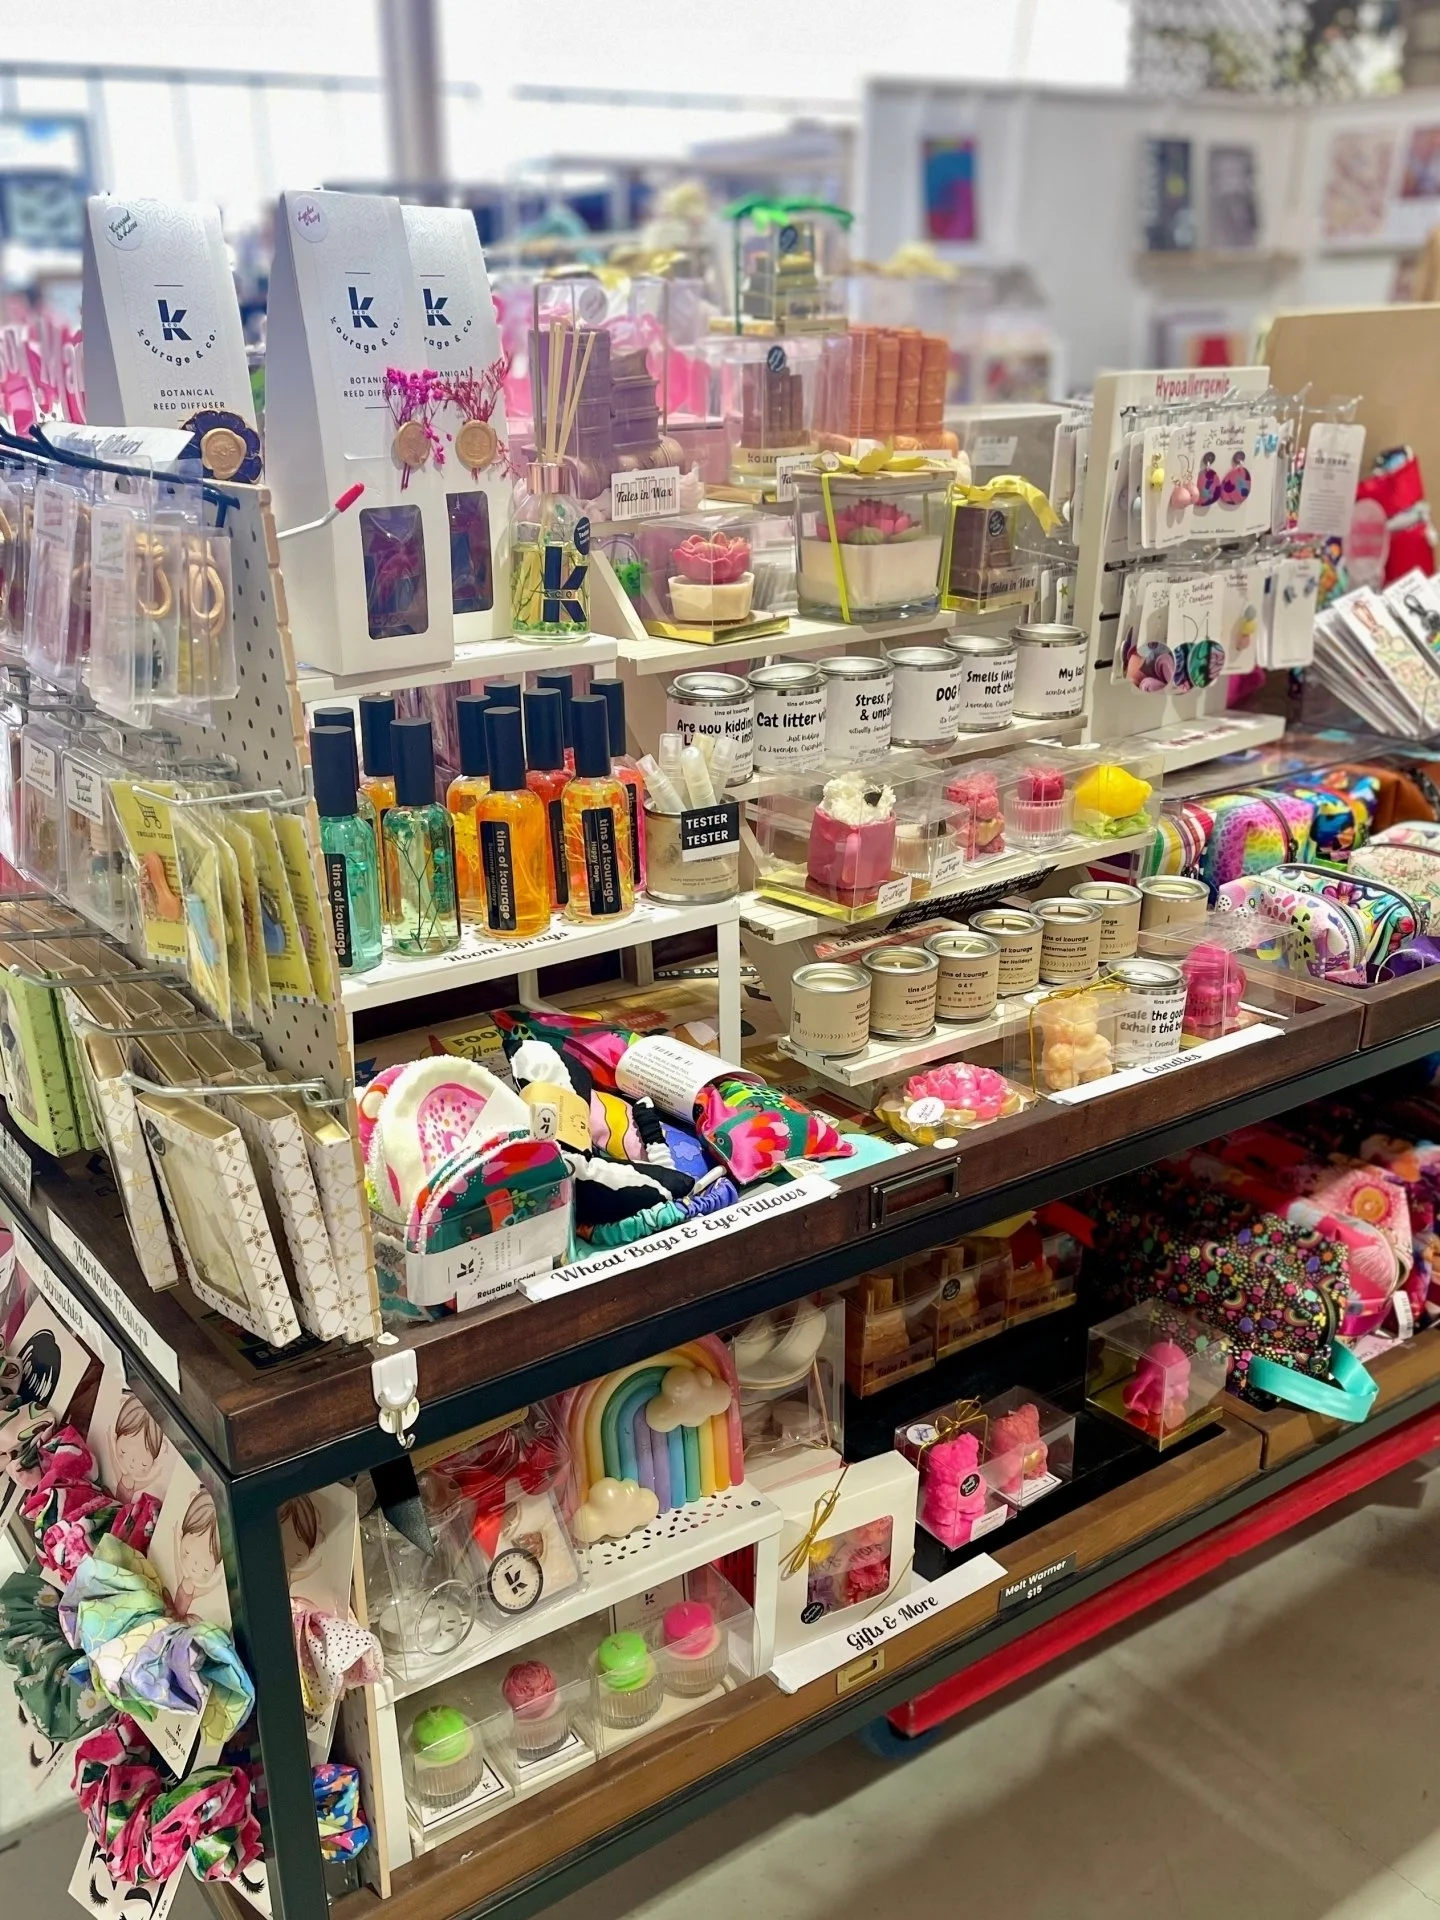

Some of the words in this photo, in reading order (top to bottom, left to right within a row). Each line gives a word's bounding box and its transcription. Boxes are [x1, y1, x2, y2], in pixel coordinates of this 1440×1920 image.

[160, 388, 215, 398] BOTANICAL
[343, 390, 365, 398] REED
[181, 401, 225, 409] DIFFUSER
[616, 491, 639, 504] Tales
[641, 488, 650, 500] in
[651, 486, 673, 499] Wax
[967, 670, 999, 683] Smells
[1001, 670, 1013, 682] like
[1058, 668, 1074, 682] My
[936, 684, 957, 702] DOG
[985, 683, 1002, 695] not
[756, 711, 779, 728] Cat
[783, 712, 817, 728] litter
[860, 708, 870, 721] &
[677, 719, 696, 733] Are
[725, 717, 754, 734] kiddin
[600, 818, 608, 841] tins
[686, 813, 728, 830] TESTER
[496, 829, 505, 852] tins
[687, 830, 729, 846] TESTER
[591, 841, 599, 867] Happy
[601, 841, 609, 856] of
[498, 854, 508, 868] of
[331, 863, 342, 887] tins
[603, 856, 614, 903] kourage
[333, 889, 343, 905] of
[499, 868, 510, 920] kourage
[334, 904, 346, 957] kourage
[1063, 934, 1089, 943] kourage
[444, 945, 501, 963] Room
[501, 930, 570, 954] Sprays
[1008, 945, 1033, 954] kourage
[963, 970, 989, 979] kourage
[907, 985, 919, 994] tins
[905, 996, 928, 1005] Summer
[1152, 1010, 1168, 1021] the
[1120, 1020, 1157, 1034] exhale
[1159, 1023, 1174, 1034] the
[452, 1031, 498, 1047] FOO
[1142, 1052, 1202, 1076] Candles
[624, 1235, 681, 1262] Bags
[680, 1225, 699, 1239] &
[703, 1213, 738, 1232] Eye
[737, 1186, 808, 1218] Pillows
[477, 1280, 513, 1300] Reusable
[43, 1270, 84, 1331] Scrunchies
[1005, 1579, 1030, 1598] Melt
[1027, 1559, 1067, 1588] Warmer
[1026, 1584, 1043, 1600] $15
[846, 1623, 884, 1651] Gifts
[882, 1614, 898, 1630] &
[897, 1594, 939, 1621] More
